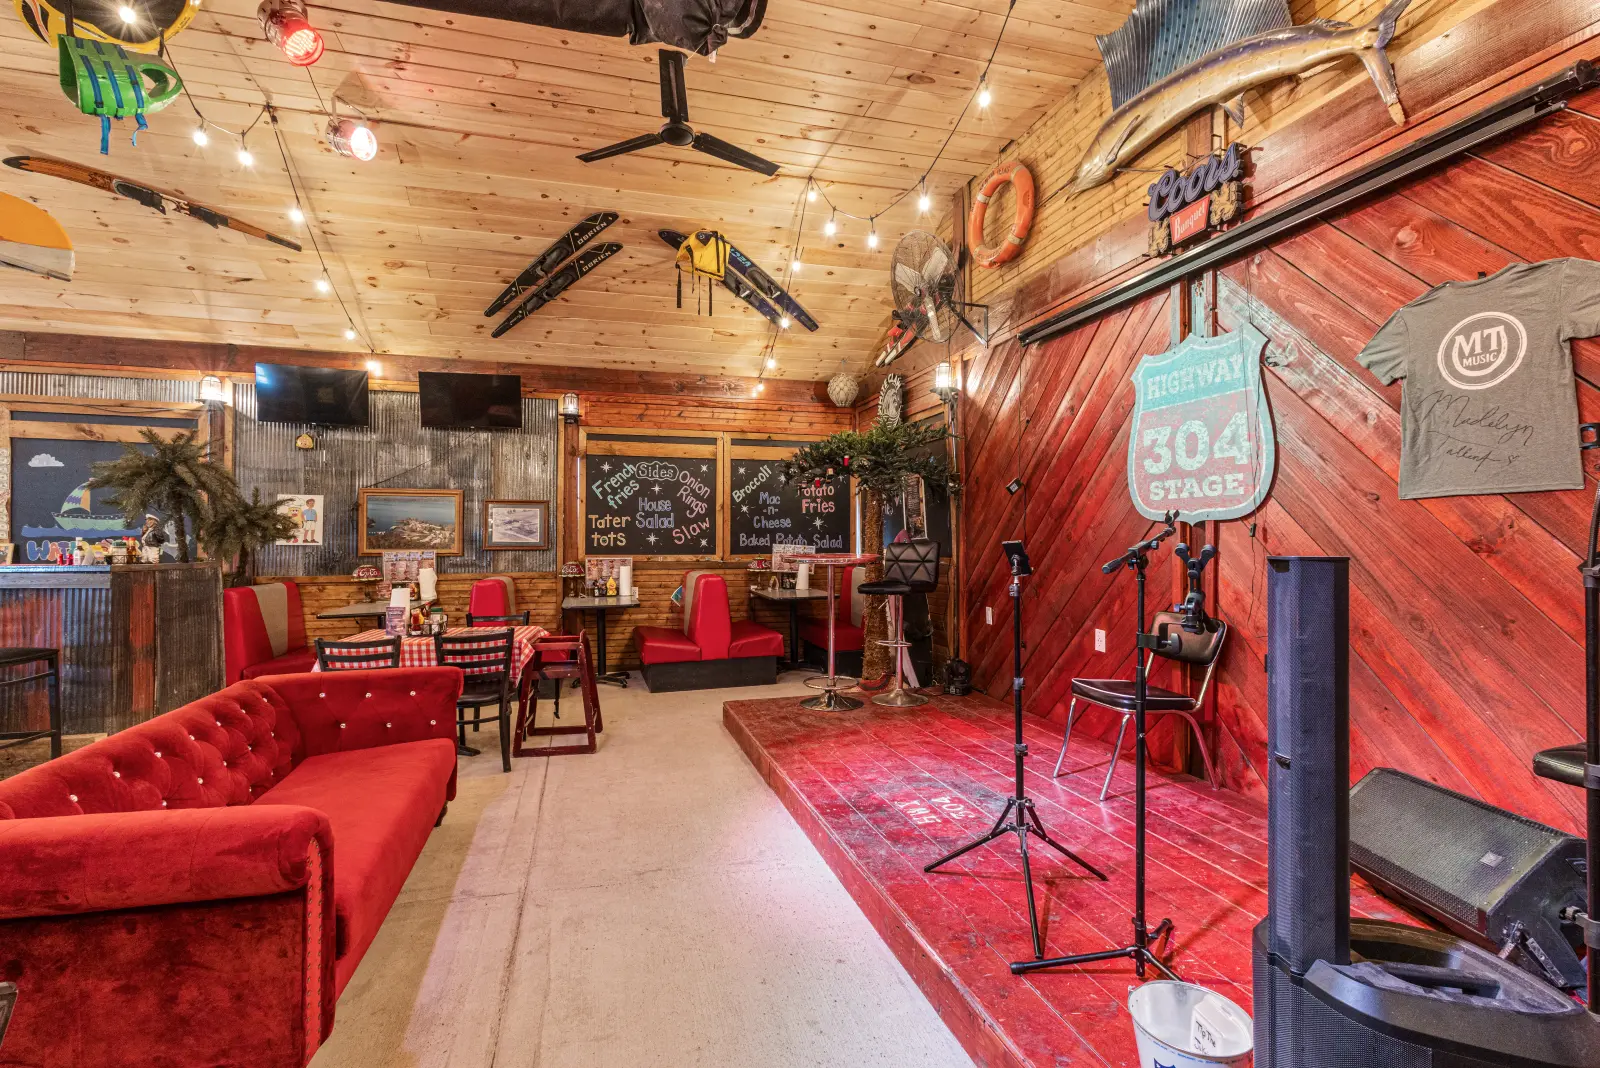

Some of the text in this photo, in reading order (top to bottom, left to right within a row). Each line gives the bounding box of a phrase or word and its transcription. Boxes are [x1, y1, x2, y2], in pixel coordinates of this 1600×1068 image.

[1147, 142, 1240, 222] Coors
[1174, 201, 1205, 241] Banquet
[1454, 325, 1505, 357] MT
[1462, 352, 1497, 367] MUSIC
[1146, 353, 1245, 400] HIGHWAY
[1143, 410, 1252, 475] 304
[591, 462, 637, 500] French
[638, 463, 674, 478] Sides
[679, 470, 711, 499] Onion
[732, 464, 772, 503] Broccoli
[607, 479, 640, 509] fries
[759, 491, 781, 505] Mac
[1149, 472, 1245, 501] STAGE
[638, 497, 672, 512] House
[676, 485, 708, 518] Rings
[801, 498, 836, 514] Fries
[588, 513, 632, 529] Tater
[635, 512, 675, 529] Salad
[672, 517, 710, 545] Slaw
[753, 516, 792, 529] Cheese
[591, 531, 627, 547] tots
[739, 533, 771, 547] Baked
[812, 534, 843, 549] Salad
